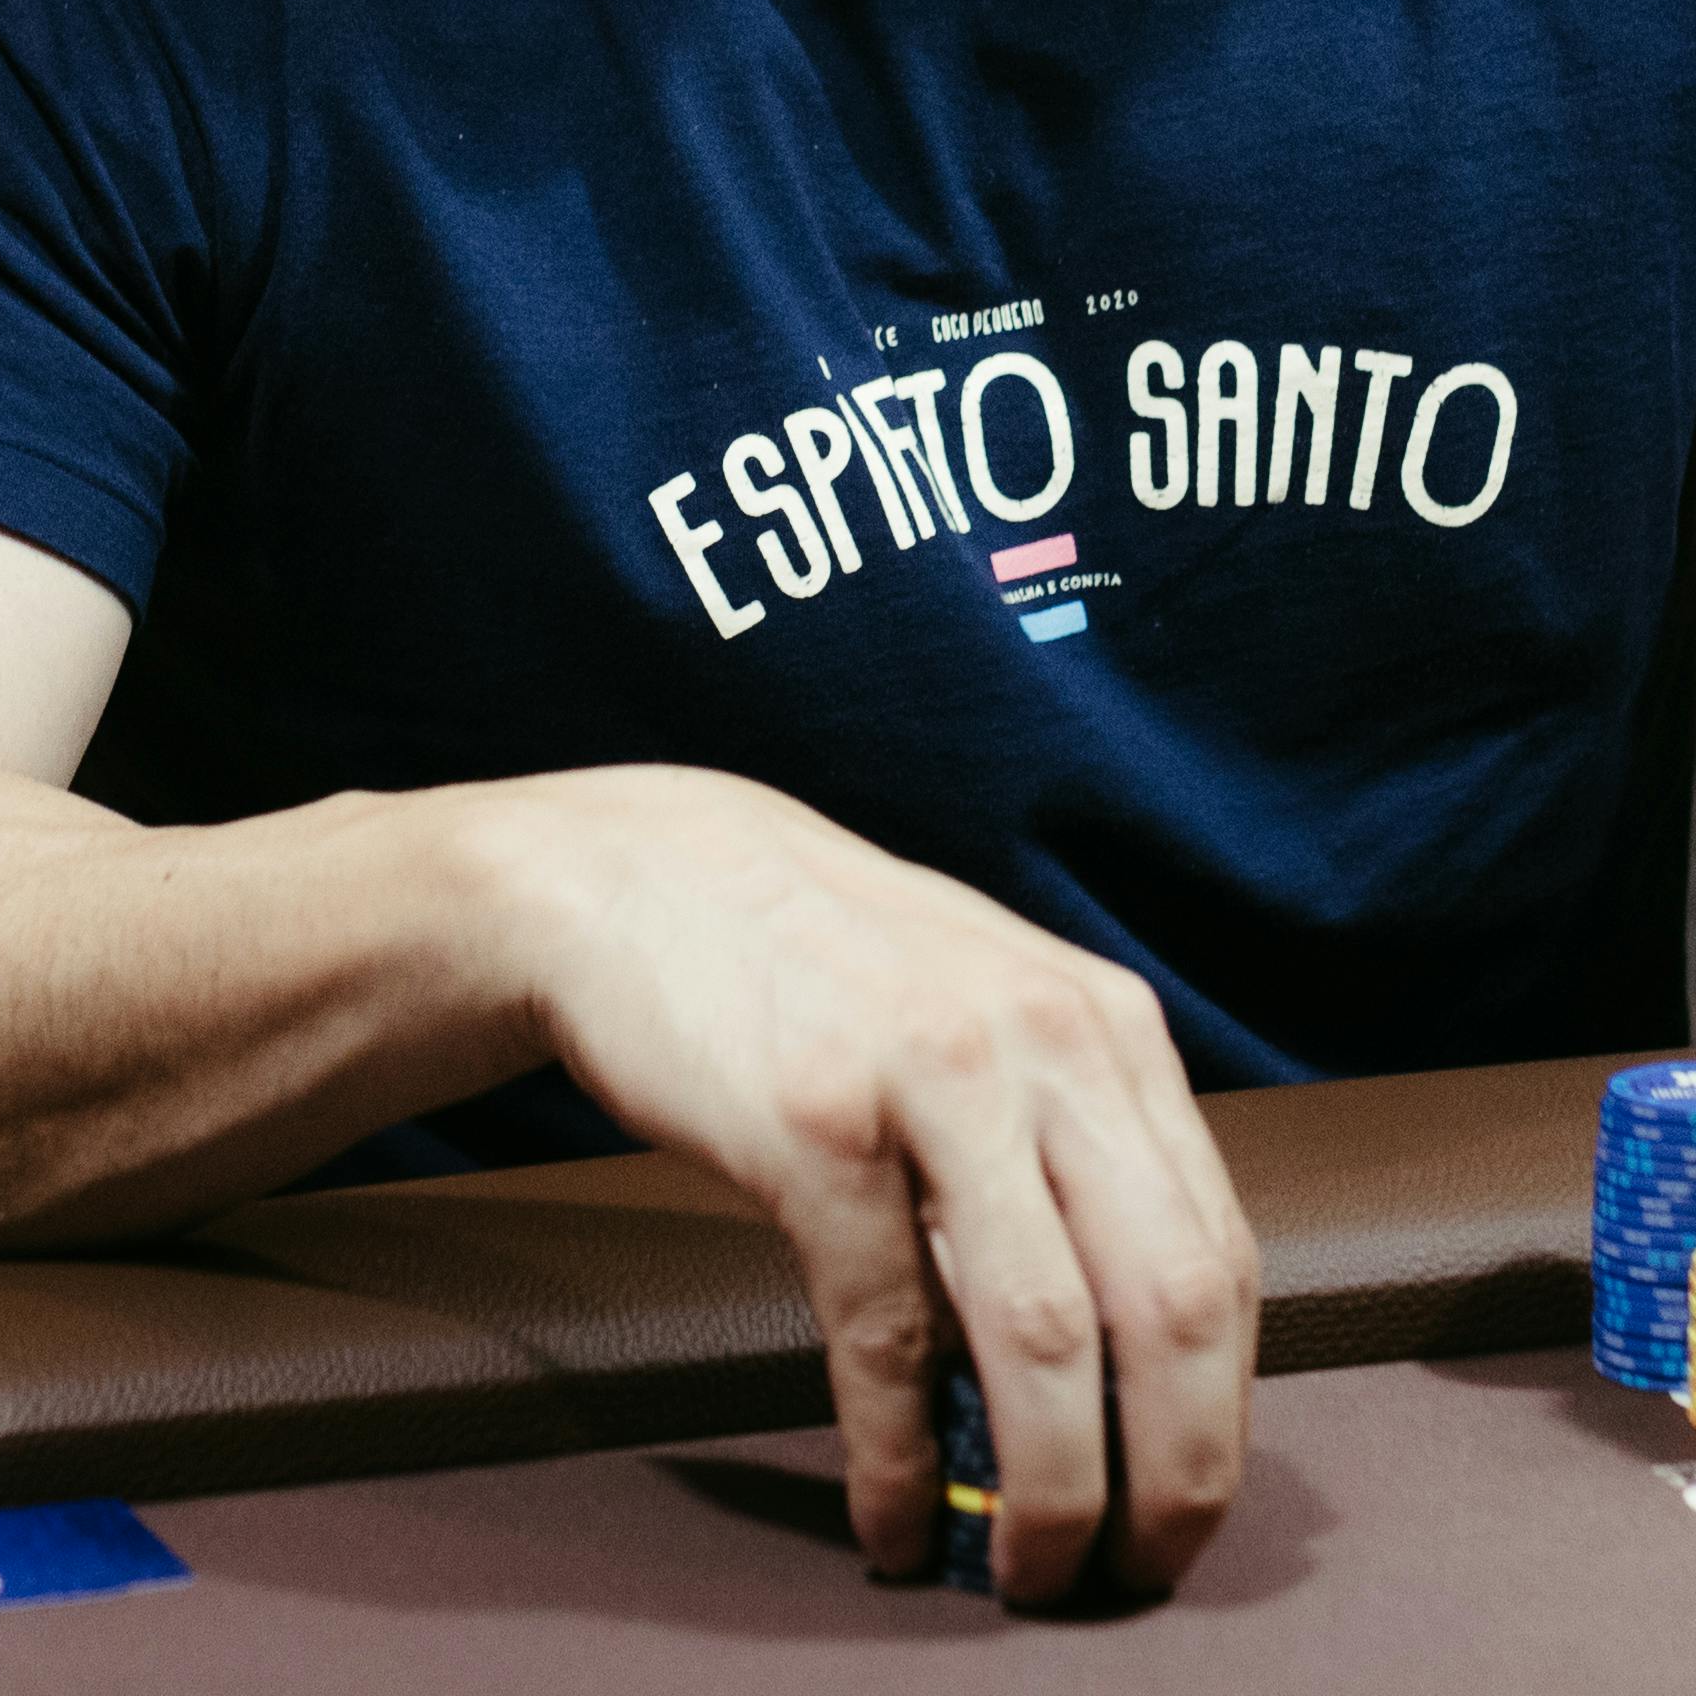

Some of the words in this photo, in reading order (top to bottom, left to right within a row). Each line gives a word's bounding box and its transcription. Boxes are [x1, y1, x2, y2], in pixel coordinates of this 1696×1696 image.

[931, 312, 969, 343] COCO
[1085, 289, 1138, 315] 2020
[1127, 339, 1517, 529] SANTO
[1046, 579, 1056, 595] E
[1059, 572, 1121, 591] CONFIA
